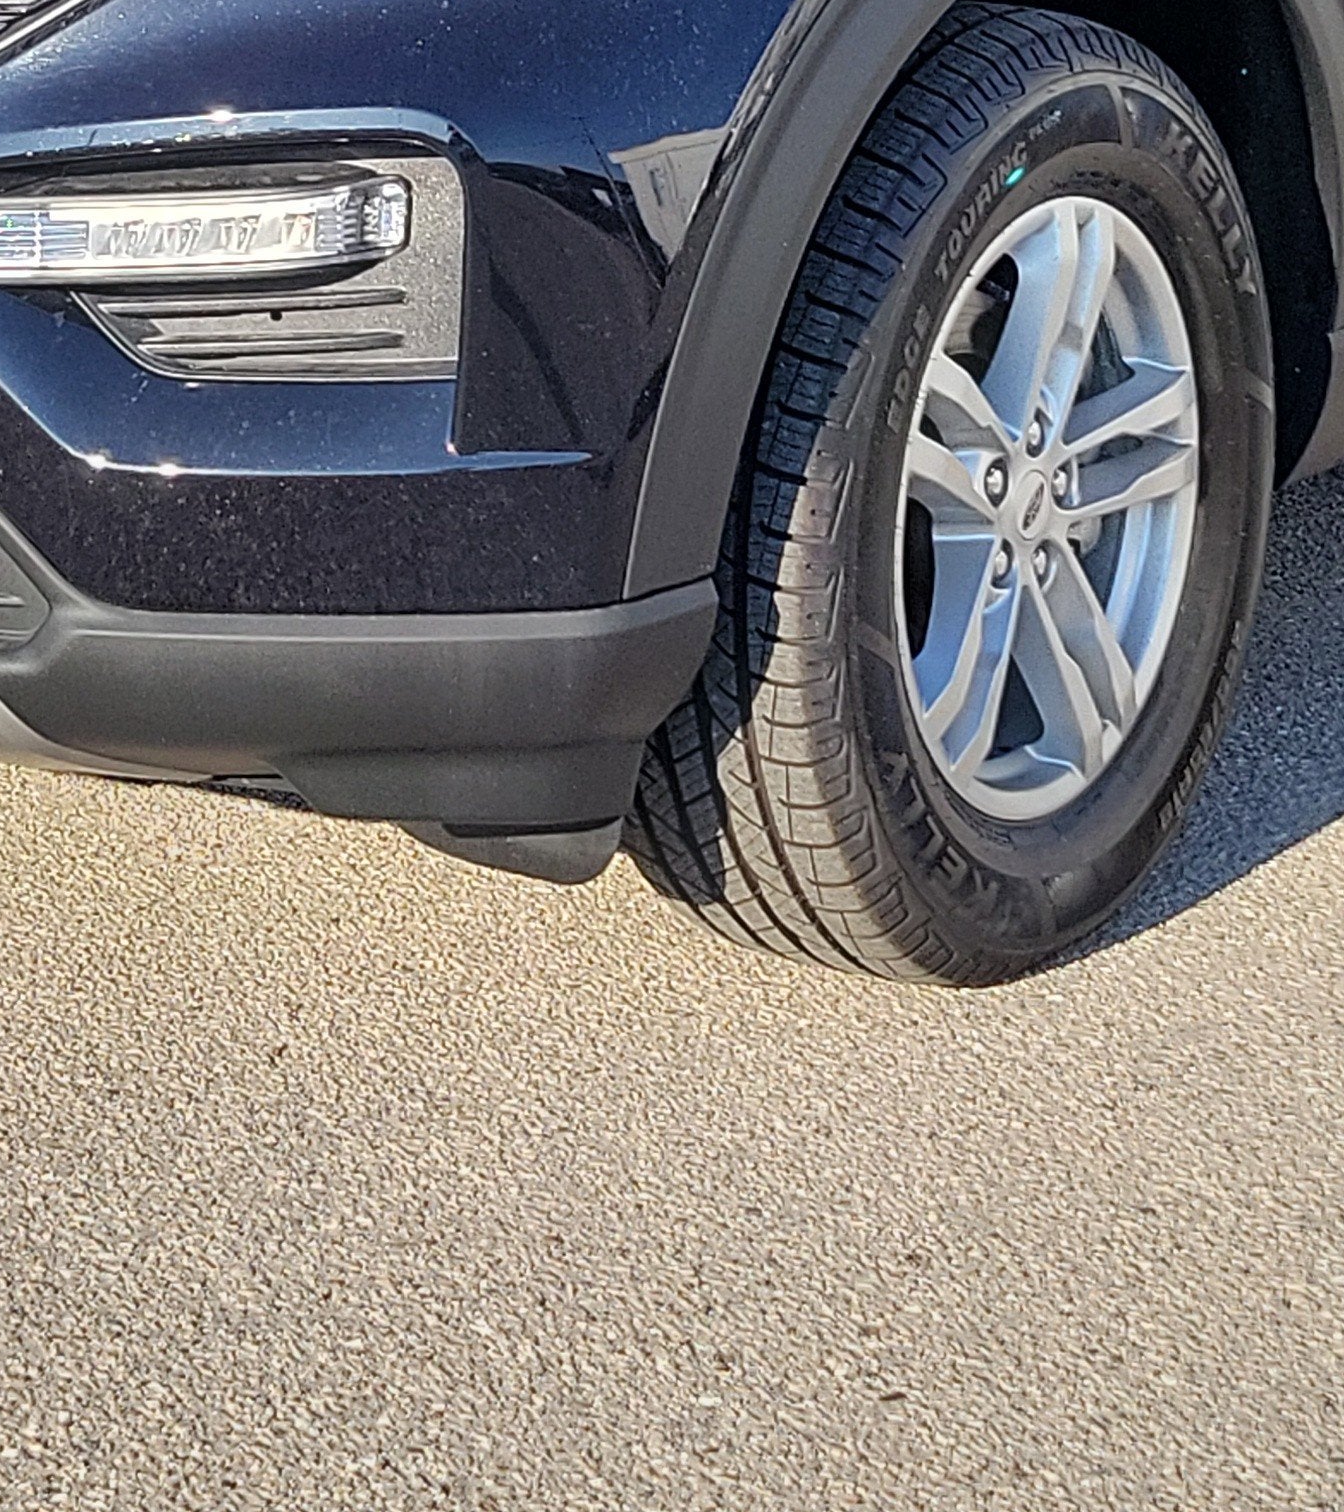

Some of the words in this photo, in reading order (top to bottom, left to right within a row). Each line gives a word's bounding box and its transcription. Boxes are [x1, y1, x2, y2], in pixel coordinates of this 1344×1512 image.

[887, 304, 931, 434] EDGE
[934, 141, 1028, 281] TOURING
[1159, 121, 1257, 296] KELLY
[878, 751, 999, 916] KELLY
